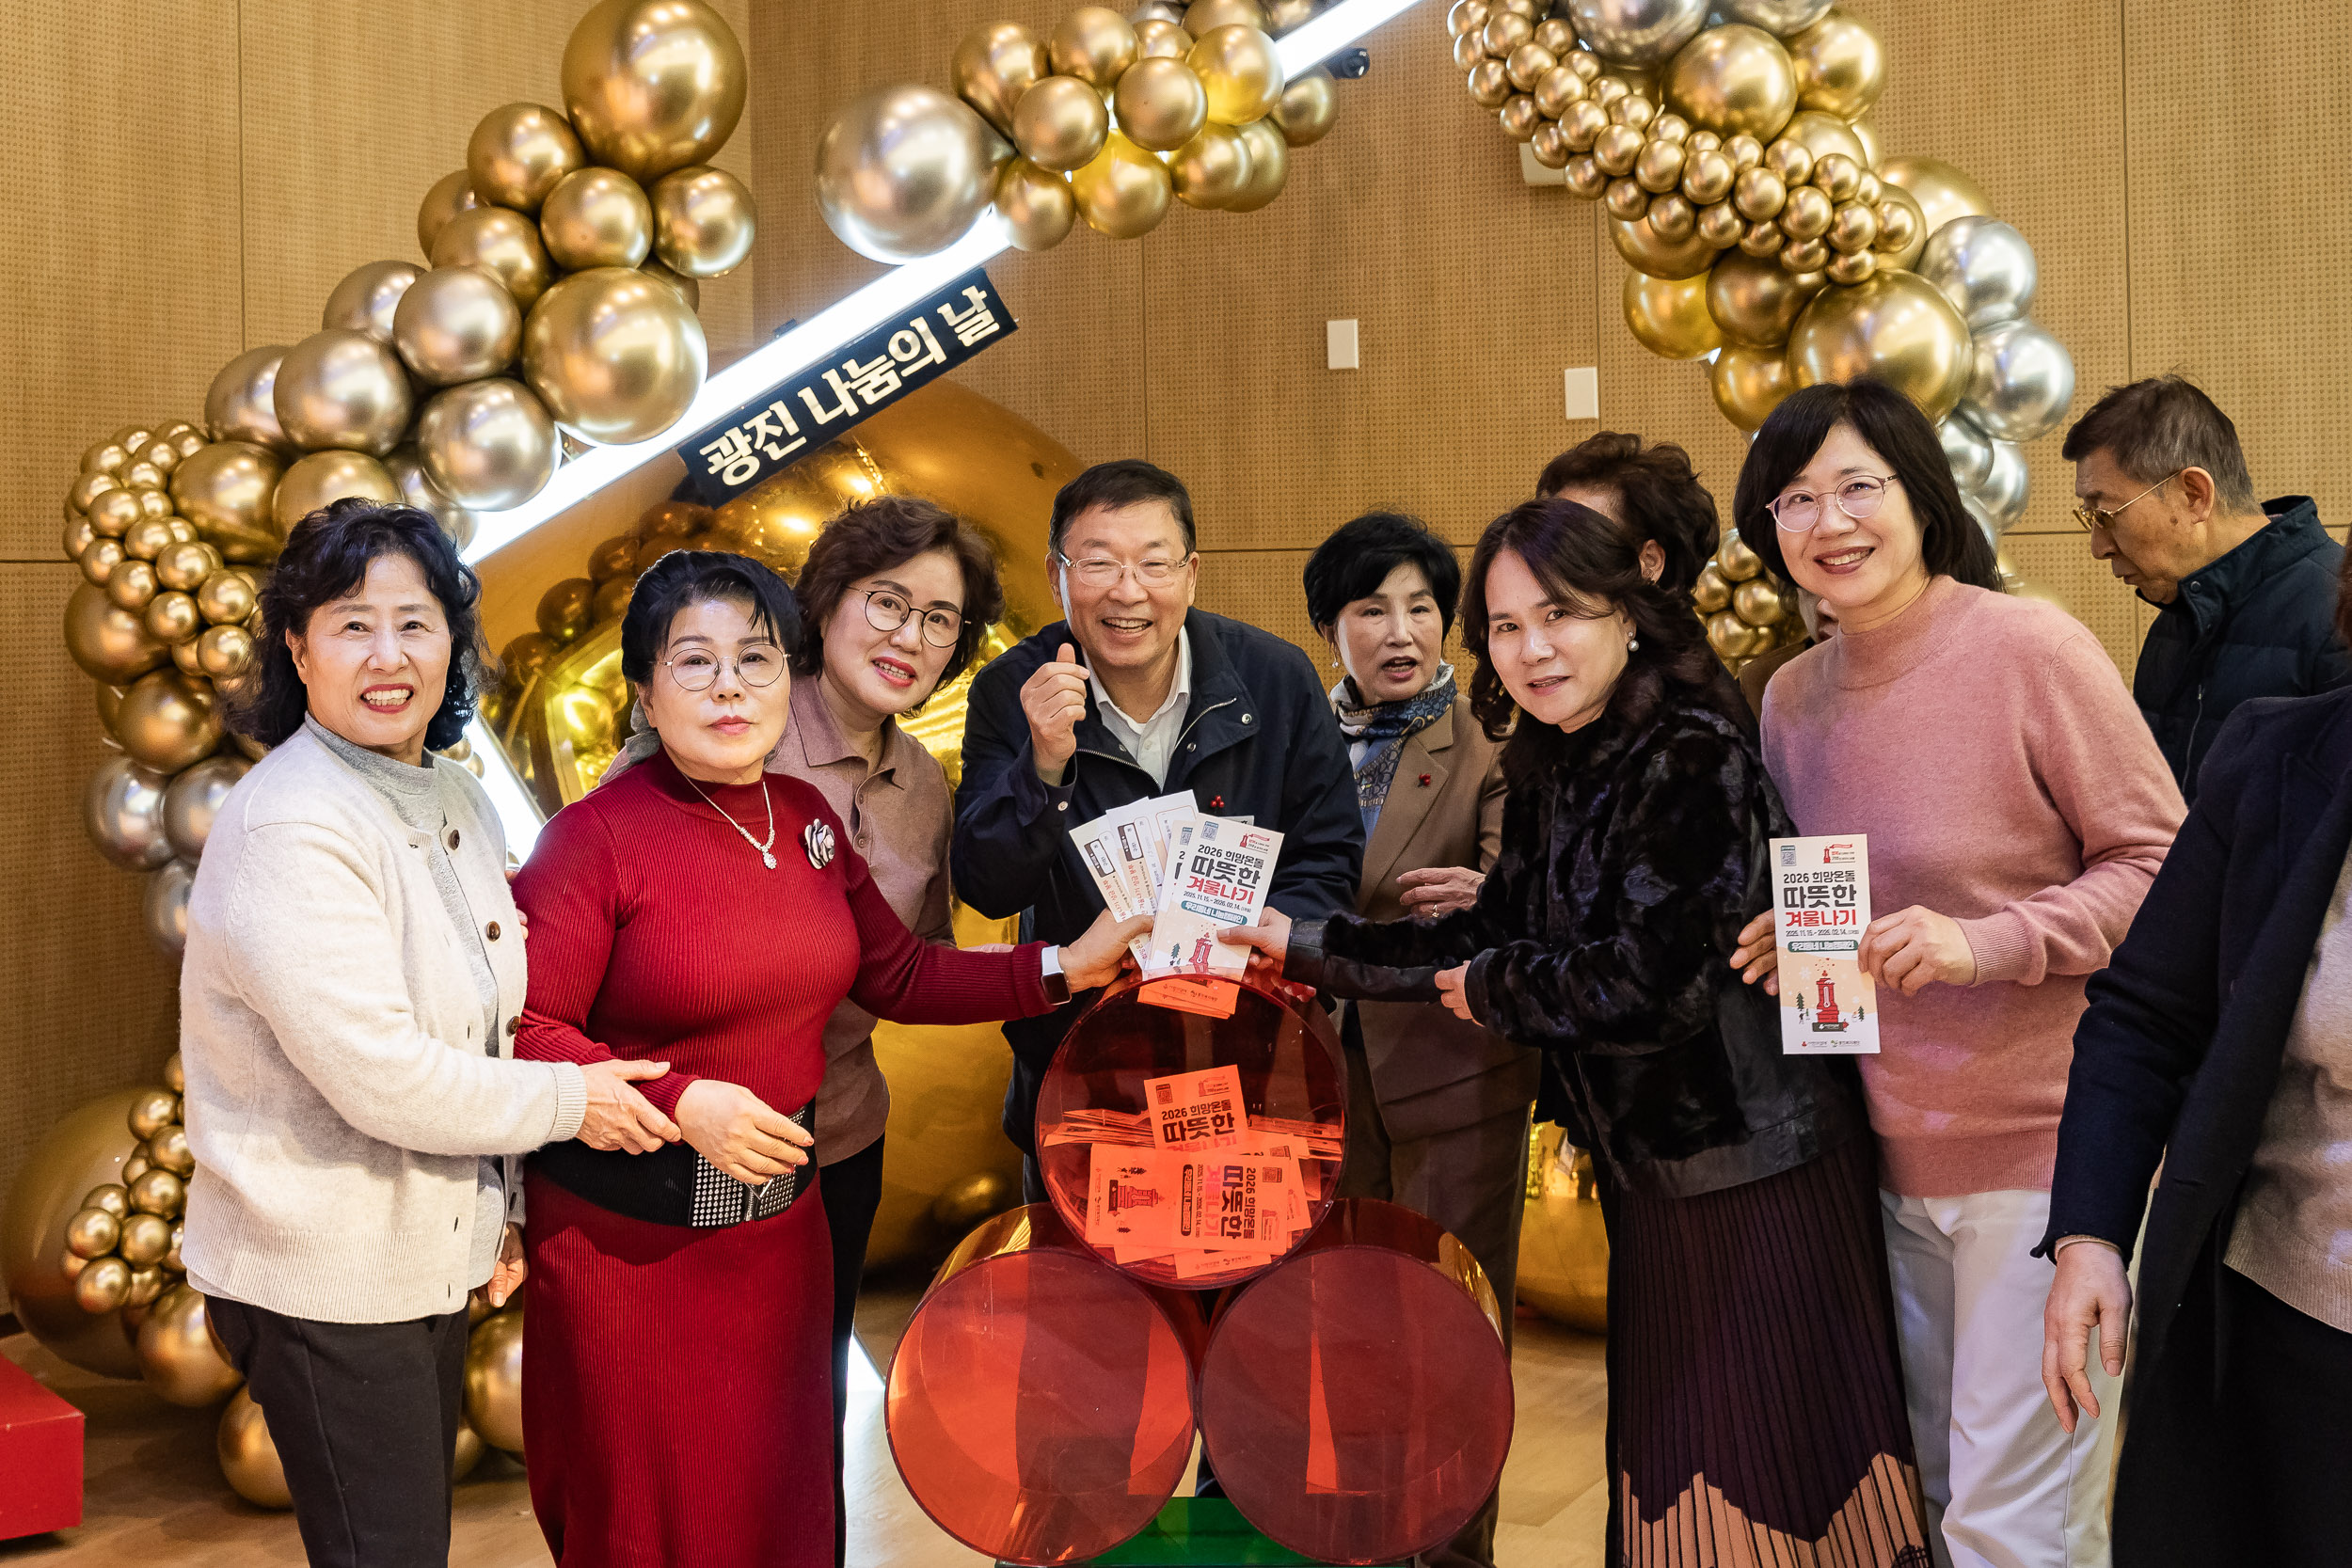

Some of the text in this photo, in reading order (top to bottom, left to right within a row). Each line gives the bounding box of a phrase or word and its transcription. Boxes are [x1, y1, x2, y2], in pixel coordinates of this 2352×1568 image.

[699, 285, 1000, 485] 광진 나눔의 날
[1198, 844, 1223, 858] 2026
[1224, 850, 1264, 869] 희망온돌
[1190, 855, 1262, 889] 따뜻한
[1783, 870, 1856, 883] 2026 희망온돌
[1186, 876, 1255, 905] 겨울나기
[1783, 884, 1857, 909] 따뜻한
[1786, 910, 1857, 927] 겨울나기
[1161, 1099, 1232, 1120] 2026 희망온돌
[1163, 1112, 1235, 1143] 따뜻한
[1204, 1165, 1220, 1236] 겨울나기
[1221, 1164, 1243, 1240] 따뜻한
[1244, 1167, 1256, 1239] 2026 희망온돌
